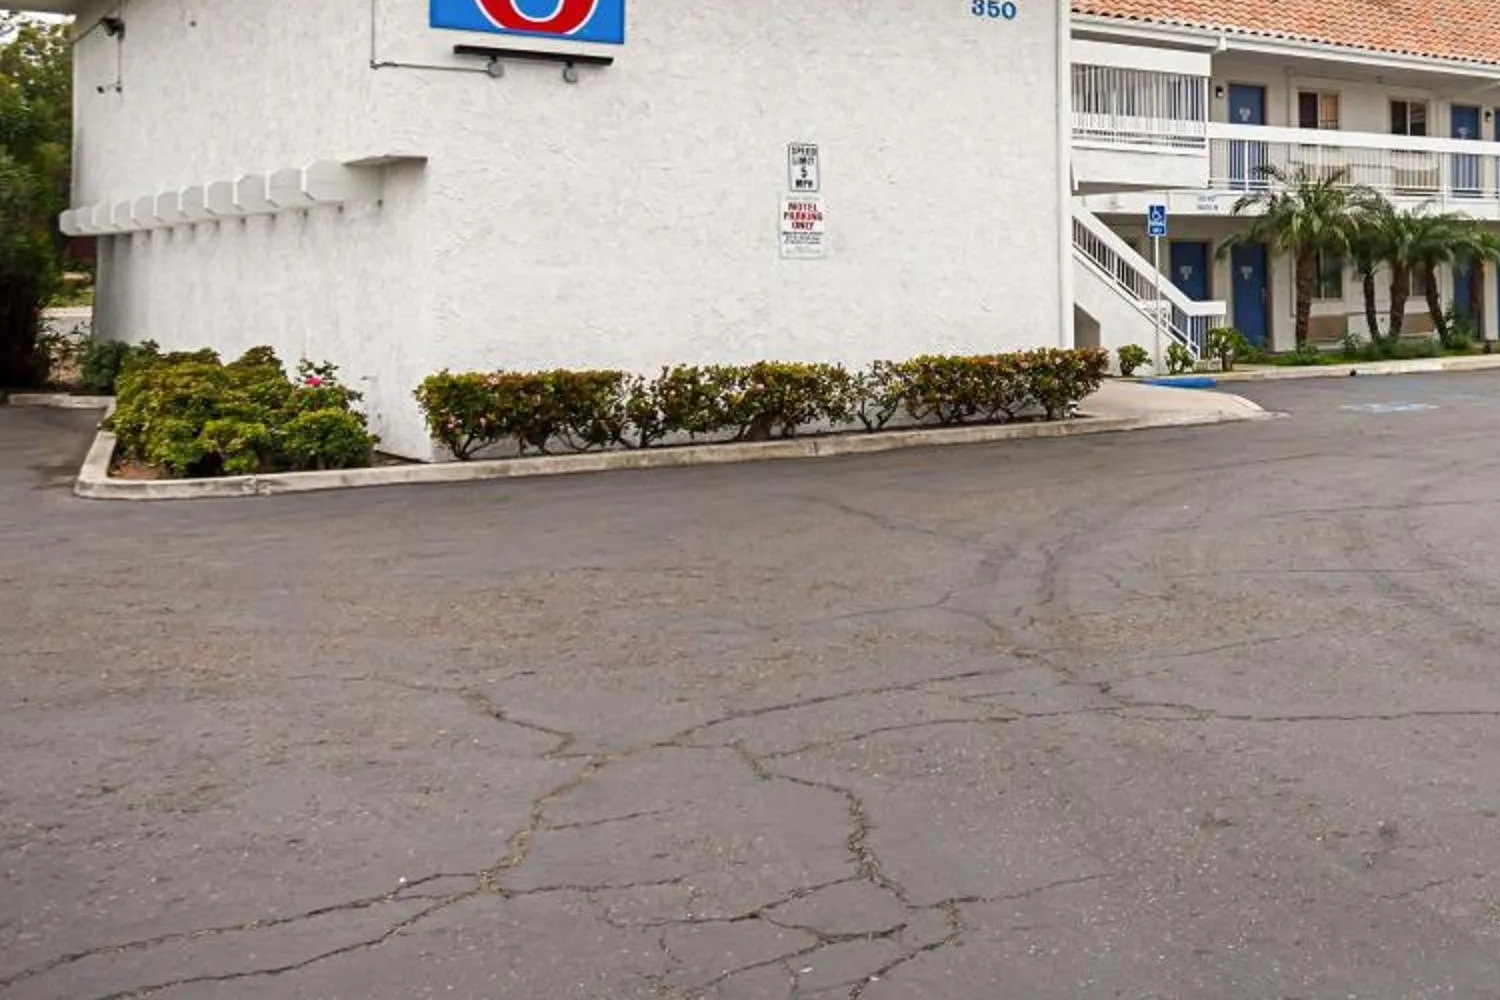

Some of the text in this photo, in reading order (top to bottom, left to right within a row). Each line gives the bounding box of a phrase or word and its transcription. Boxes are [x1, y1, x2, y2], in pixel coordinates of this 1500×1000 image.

[791, 147, 818, 156] SPEED
[792, 157, 814, 166] LIMIT
[800, 167, 808, 178] 5
[796, 179, 813, 188] MPH
[783, 212, 823, 221] PARKING
[791, 221, 814, 230] ONLY
